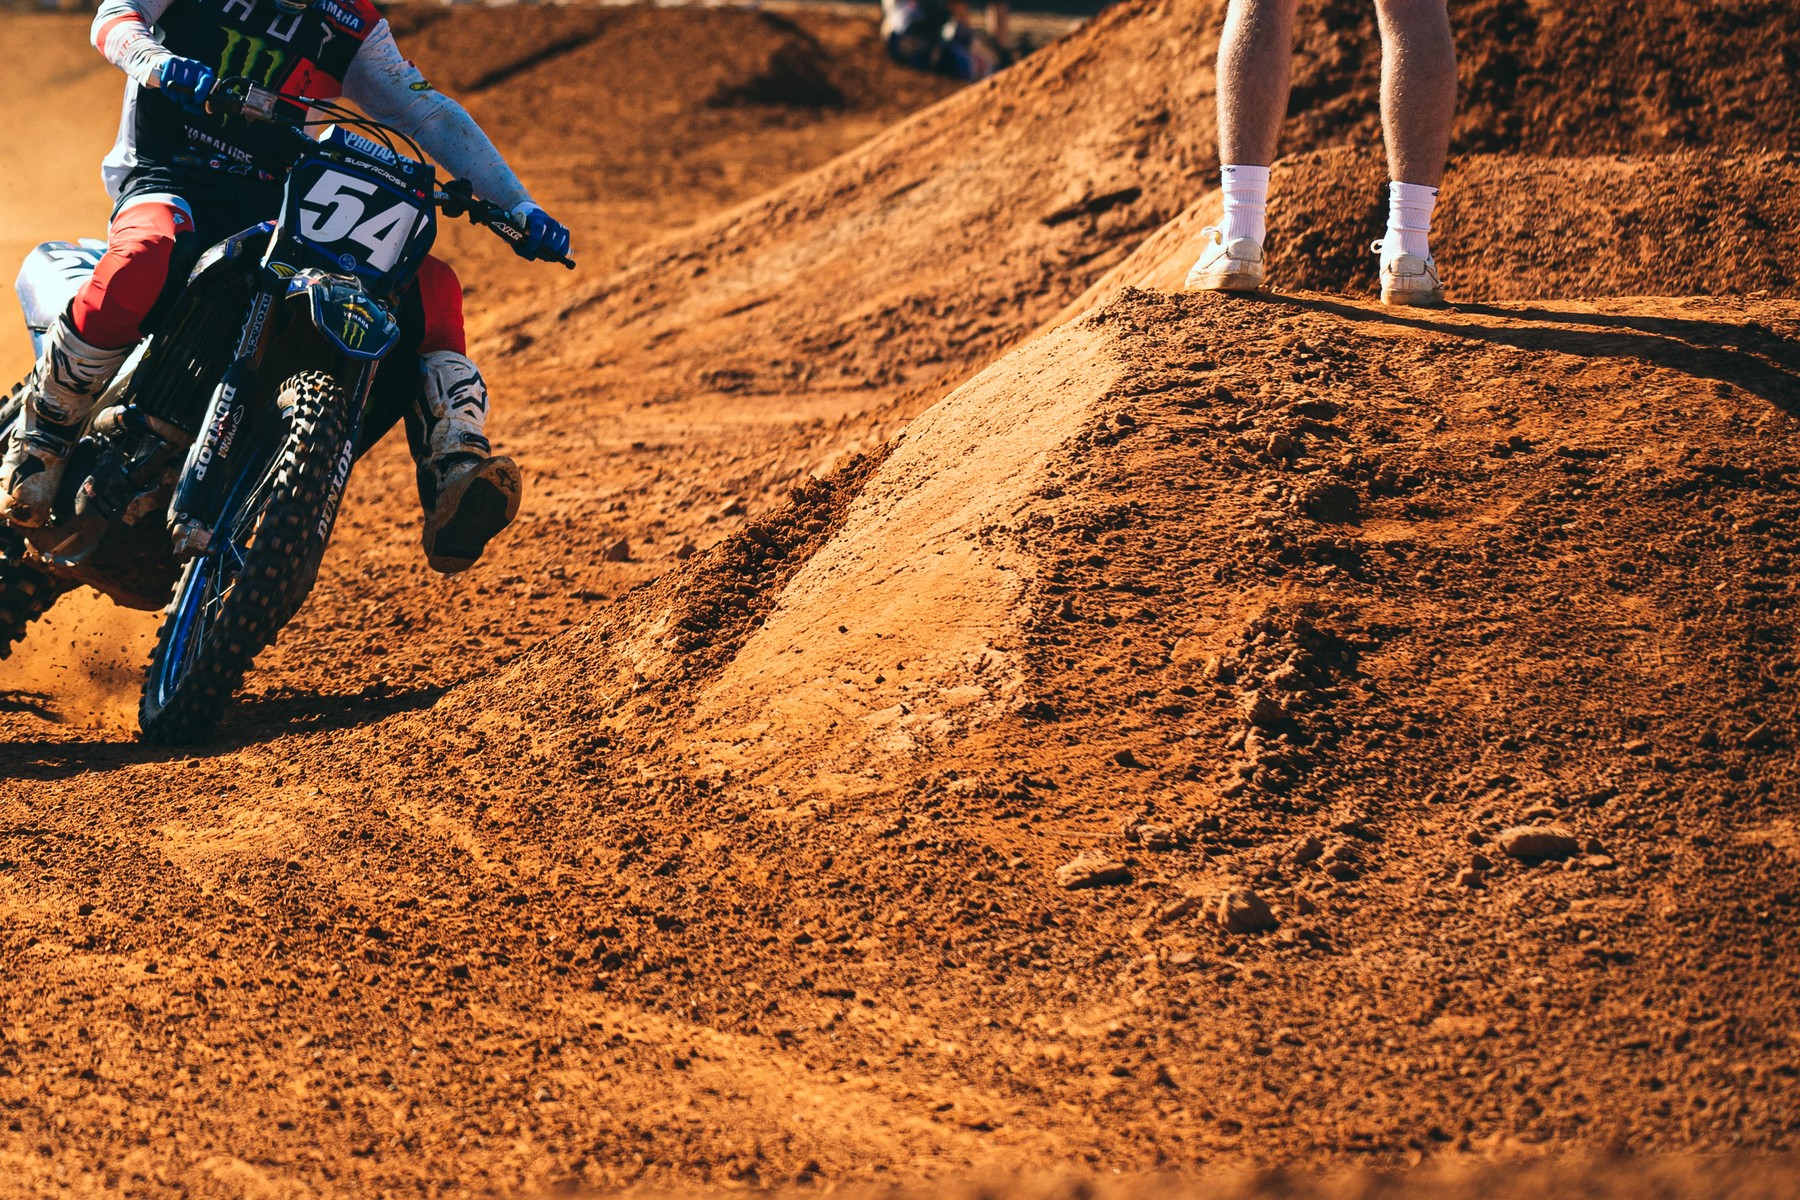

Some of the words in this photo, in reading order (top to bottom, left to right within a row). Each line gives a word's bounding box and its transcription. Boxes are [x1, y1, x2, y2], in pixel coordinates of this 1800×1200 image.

[314, 0, 359, 29] YAMAHA
[345, 157, 407, 188] SUPERCROSS
[299, 169, 429, 273] 54
[491, 221, 523, 240] ARC
[342, 312, 370, 330] YAMAHA
[195, 382, 237, 481] DUNLOP
[317, 439, 354, 542] DUNLOP
